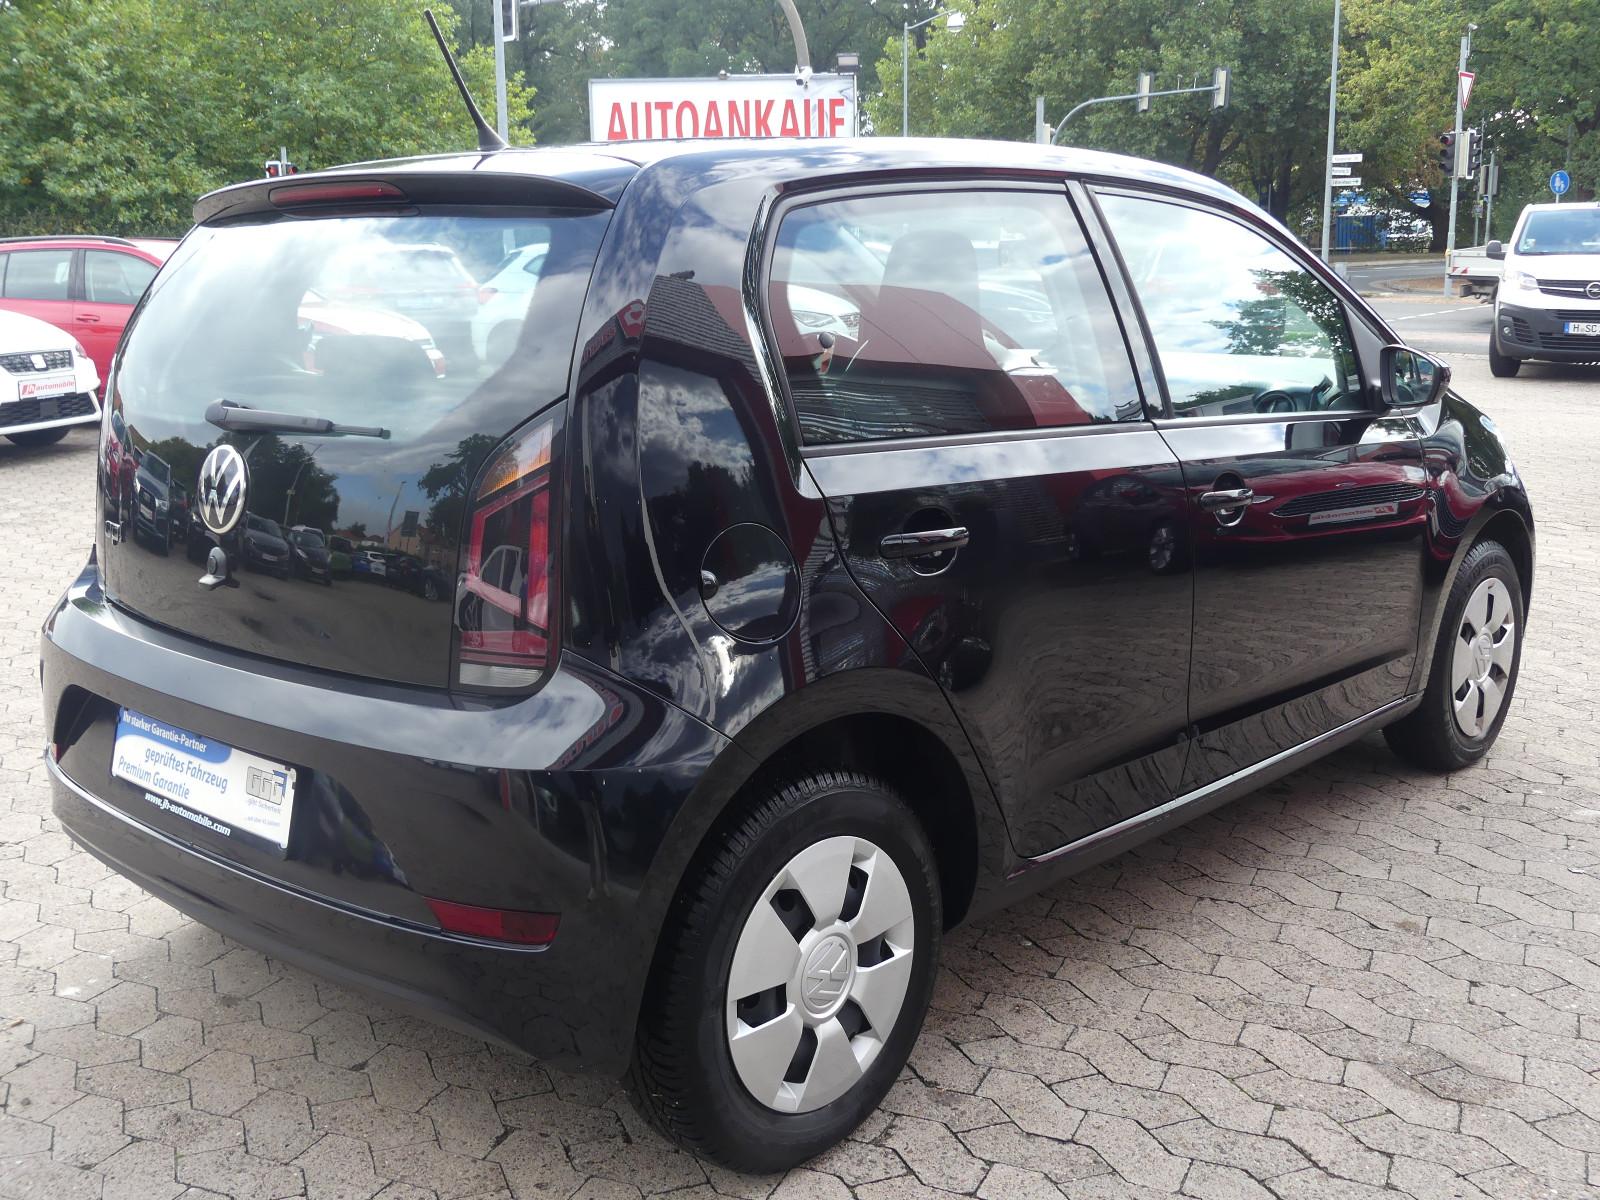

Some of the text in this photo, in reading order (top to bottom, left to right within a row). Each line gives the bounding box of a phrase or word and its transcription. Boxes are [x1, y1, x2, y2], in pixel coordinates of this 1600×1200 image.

[607, 98, 845, 140] AUTOANKAUF
[131, 717, 151, 733] starker
[151, 723, 208, 753] Garantie-Partner
[118, 755, 190, 800] Premium Garantie
[145, 747, 229, 794] geprüftes Fahrzeug
[144, 792, 231, 837] www.jh-automobile.com
